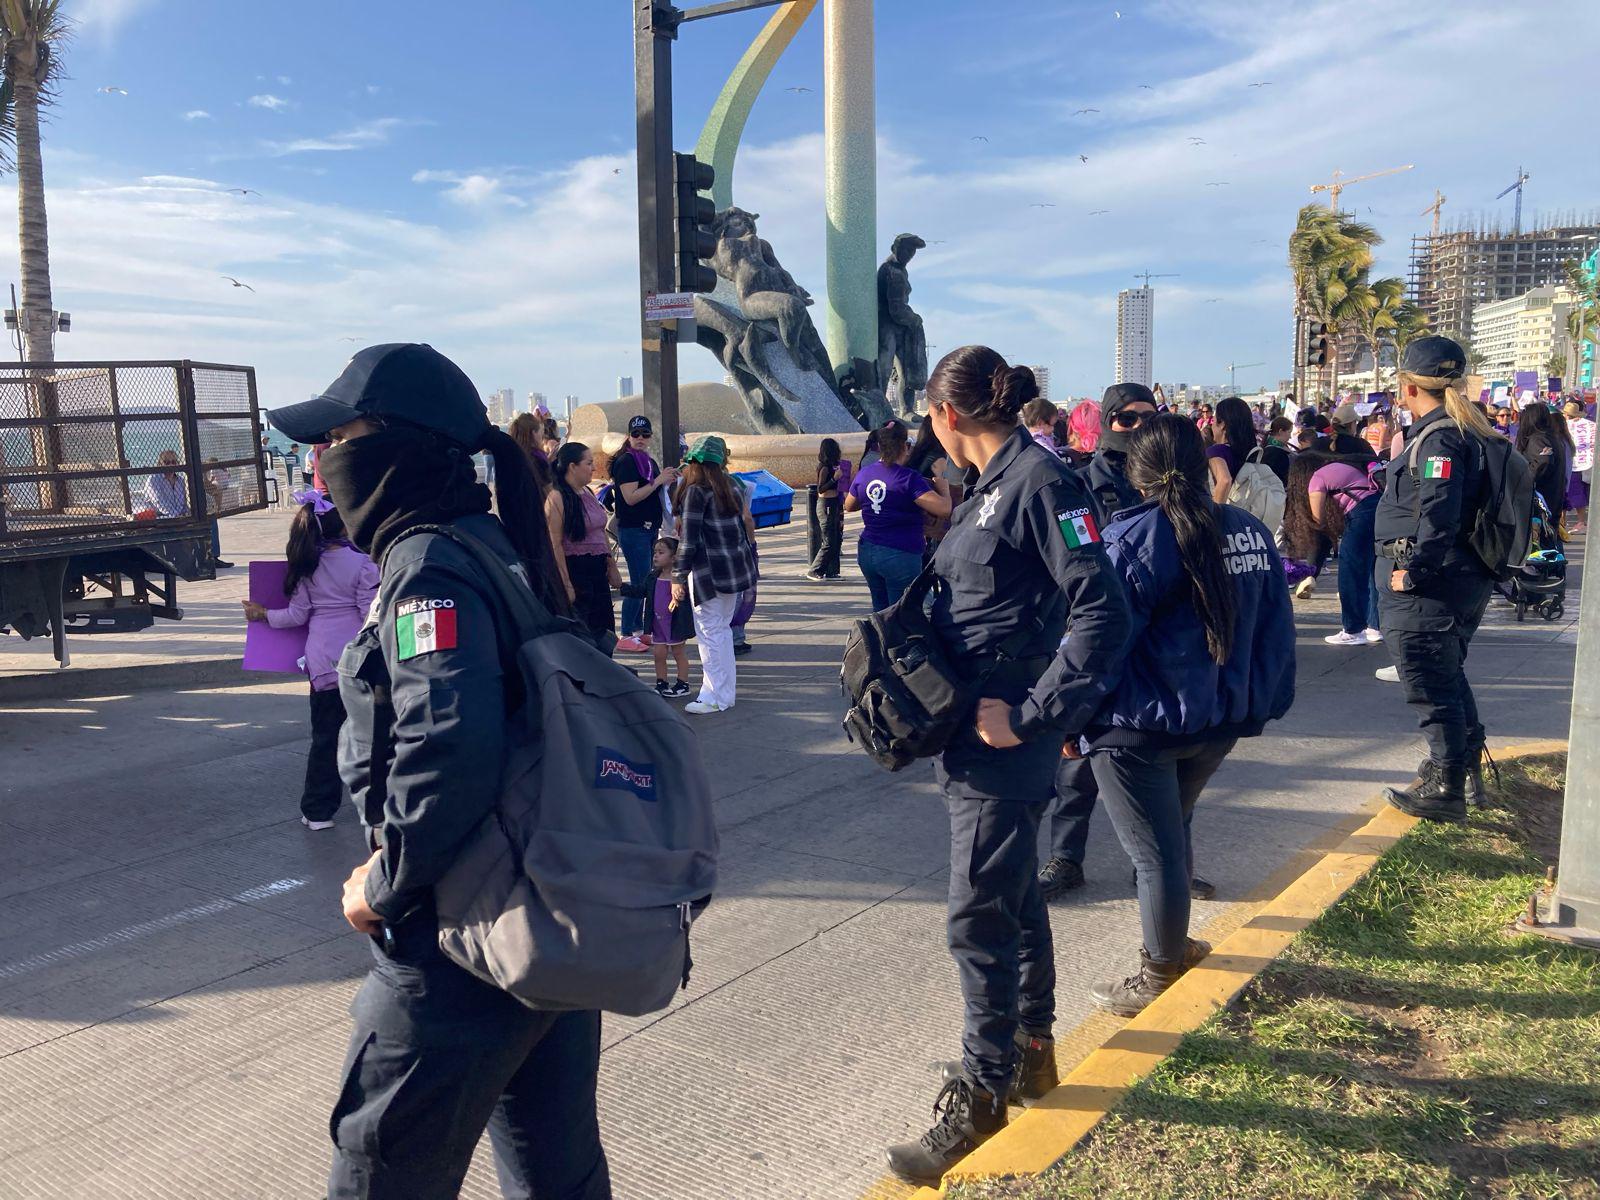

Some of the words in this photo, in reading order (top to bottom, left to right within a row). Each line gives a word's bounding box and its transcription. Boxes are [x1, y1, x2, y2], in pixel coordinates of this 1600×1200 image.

[1058, 508, 1089, 521] MÉXICO
[1222, 526, 1268, 554] ICÍA
[1223, 553, 1271, 575] ICIPAL
[398, 598, 455, 617] MÉXICO
